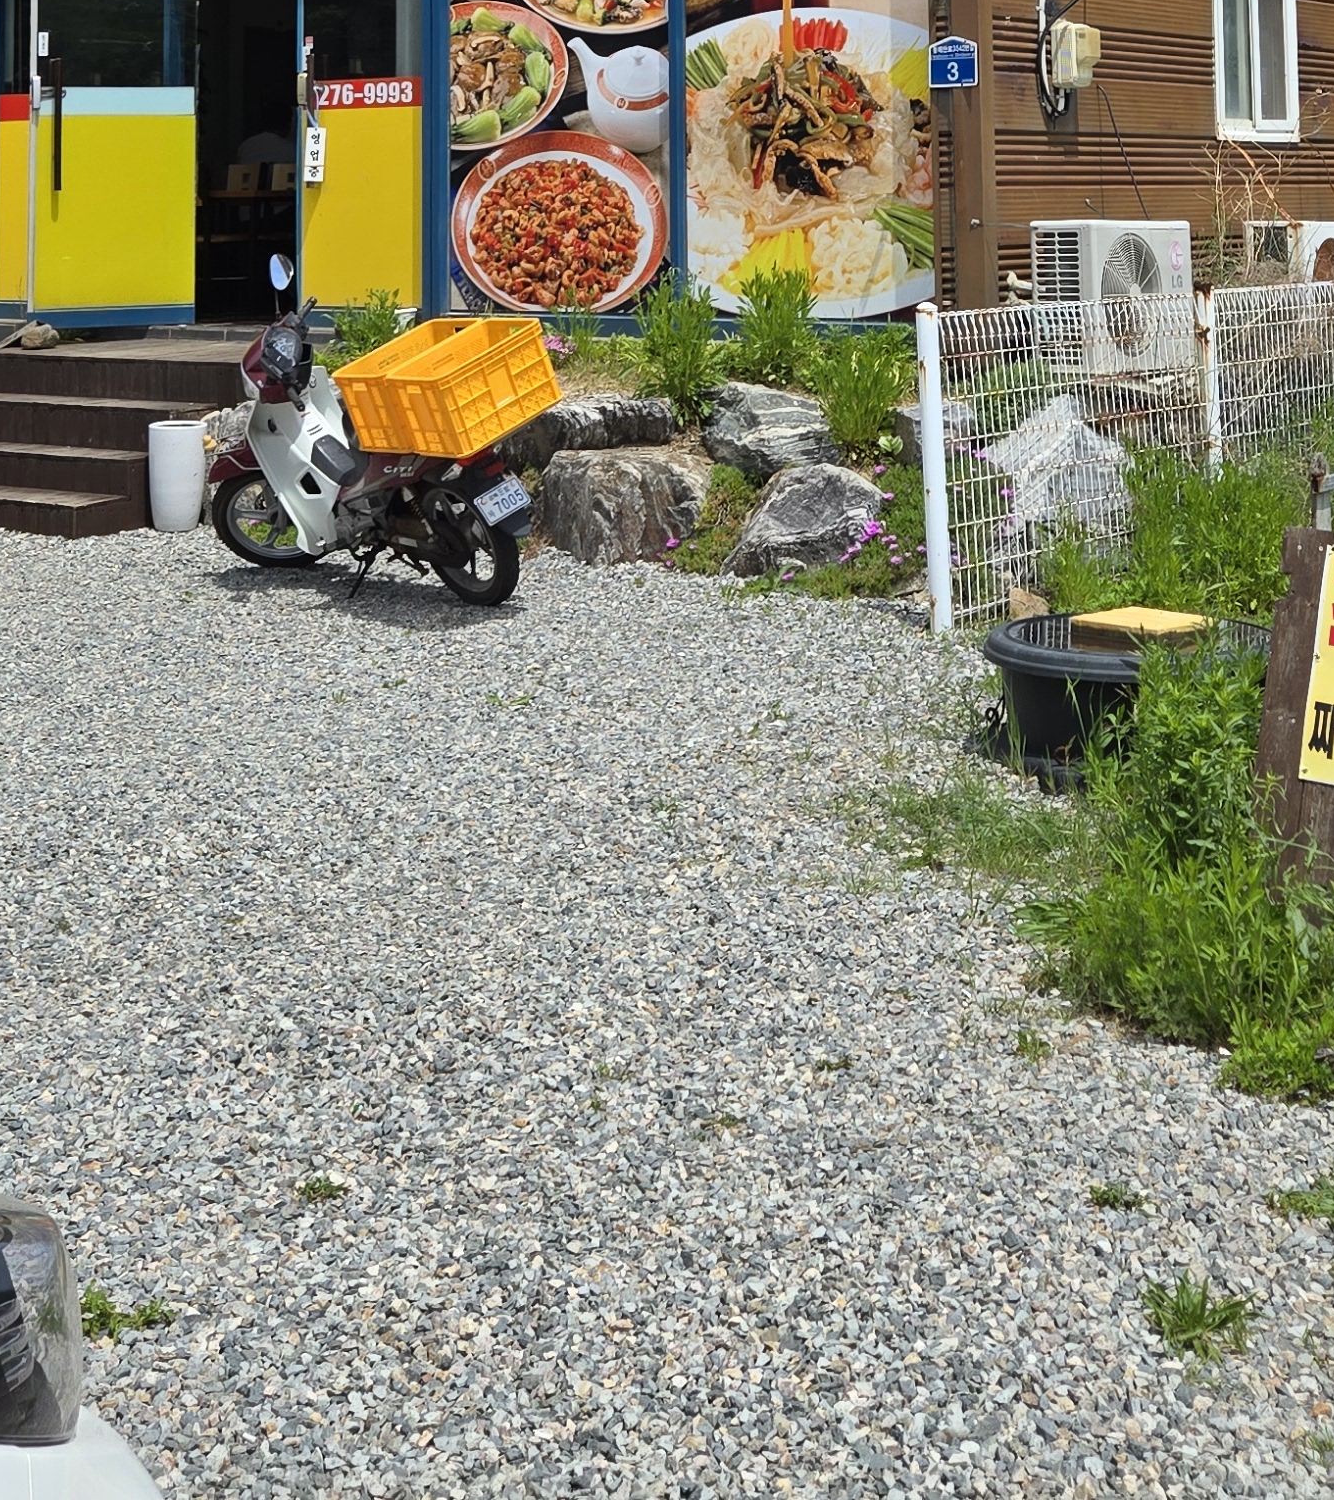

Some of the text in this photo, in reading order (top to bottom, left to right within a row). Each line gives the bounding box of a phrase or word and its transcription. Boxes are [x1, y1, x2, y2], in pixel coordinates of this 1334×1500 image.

[947, 61, 959, 82] 3
[318, 80, 413, 106] 276-9993
[1171, 275, 1184, 288] LG
[383, 465, 414, 474] CITI
[493, 488, 525, 514] 7005
